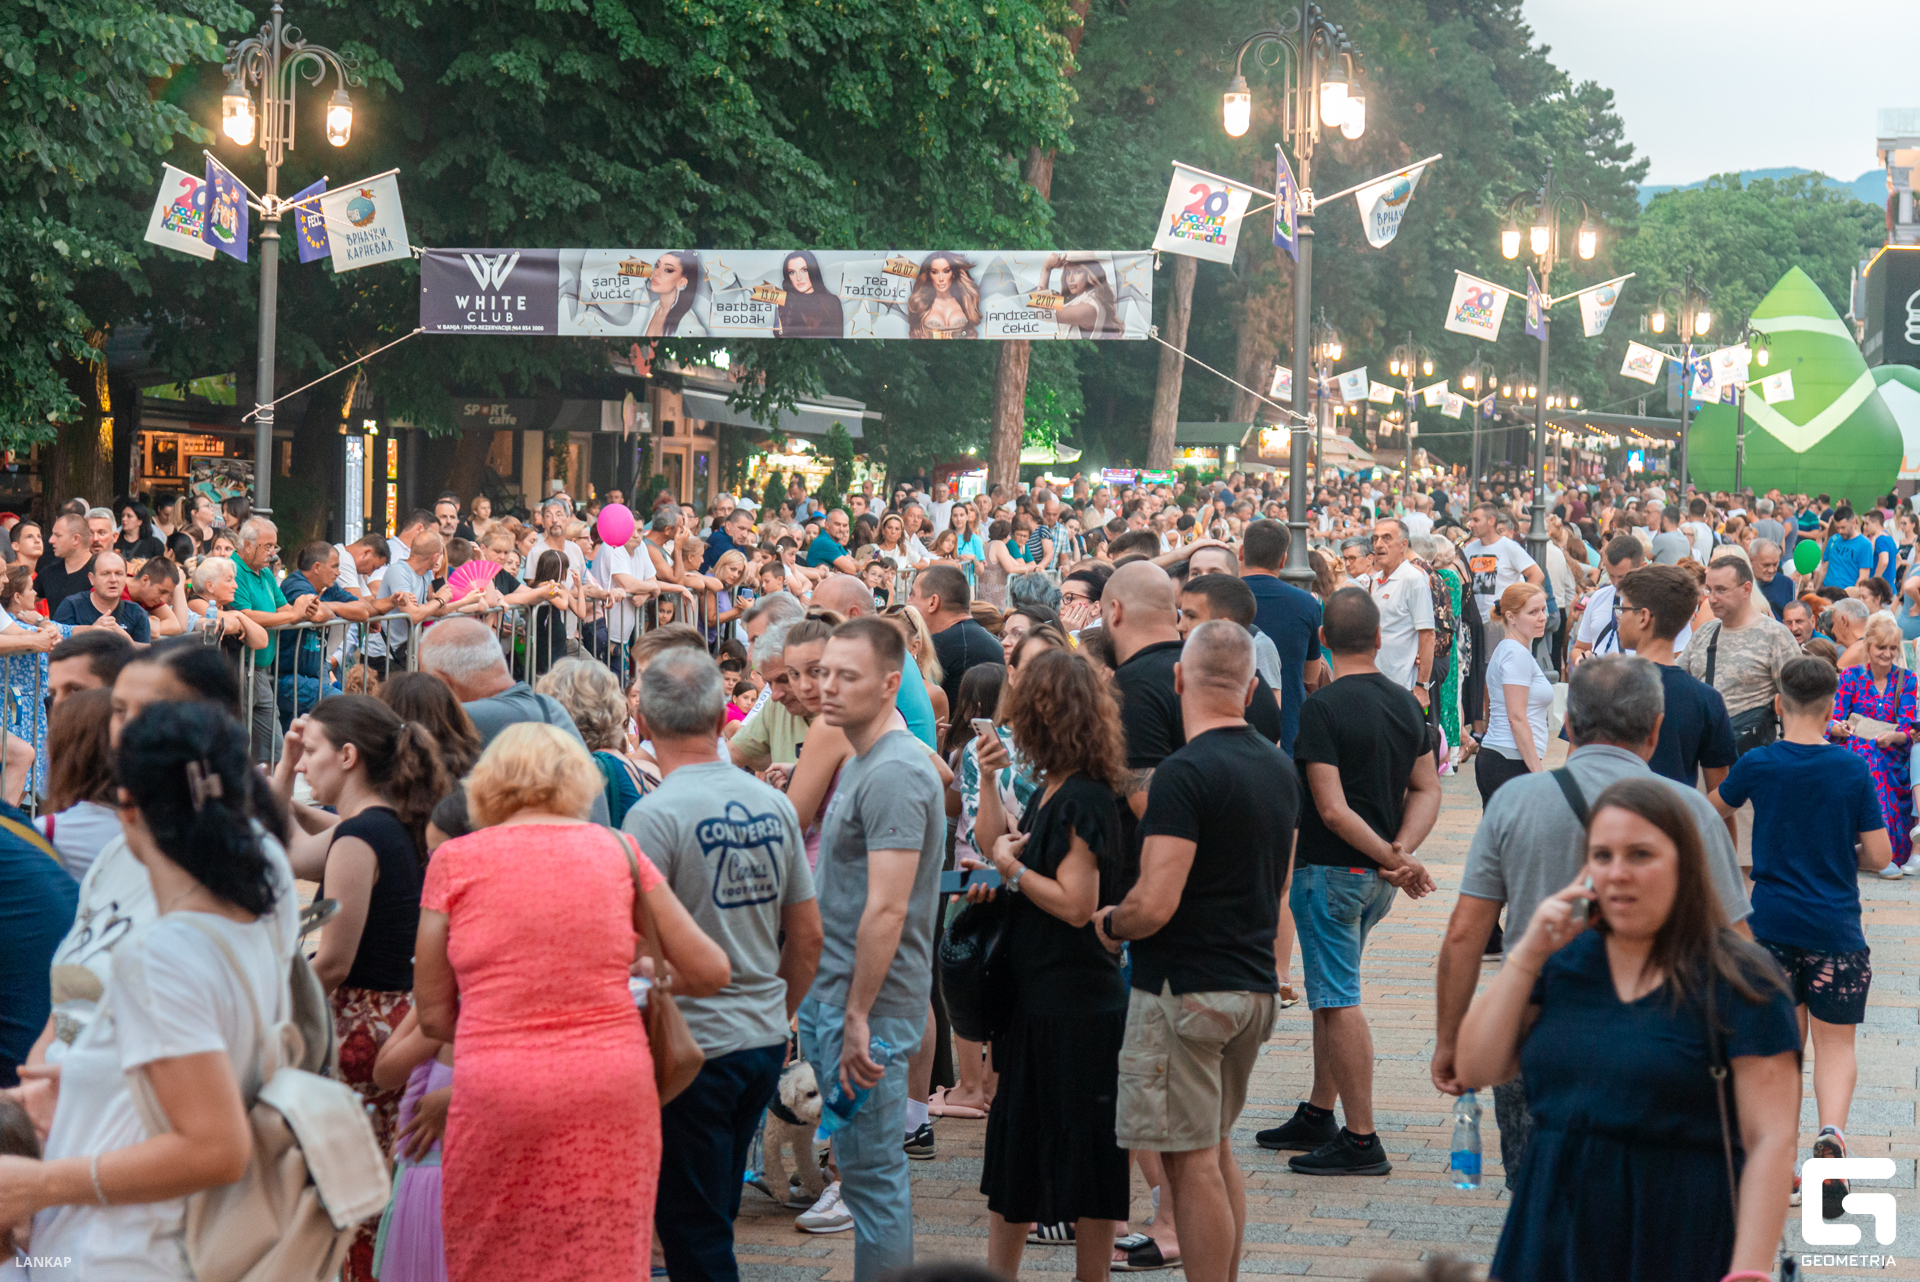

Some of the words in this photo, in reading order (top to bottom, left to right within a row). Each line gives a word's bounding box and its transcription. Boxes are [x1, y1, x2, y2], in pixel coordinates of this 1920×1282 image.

[175, 177, 206, 212] 20
[1184, 183, 1229, 217] 20
[1181, 210, 1226, 227] Godina
[1377, 208, 1404, 225] ВРЊАЧ
[161, 216, 204, 239] Karneval
[345, 227, 388, 246] ВРЊАЧКИ
[1169, 224, 1227, 245] Karnevala
[346, 240, 395, 261] КАРНЕВАЛ
[864, 276, 888, 286] Tea
[455, 295, 526, 310] WHITE
[1464, 286, 1494, 310] 20
[467, 311, 514, 323] CLUB
[463, 403, 509, 416] SPORT
[488, 413, 517, 425] caffe
